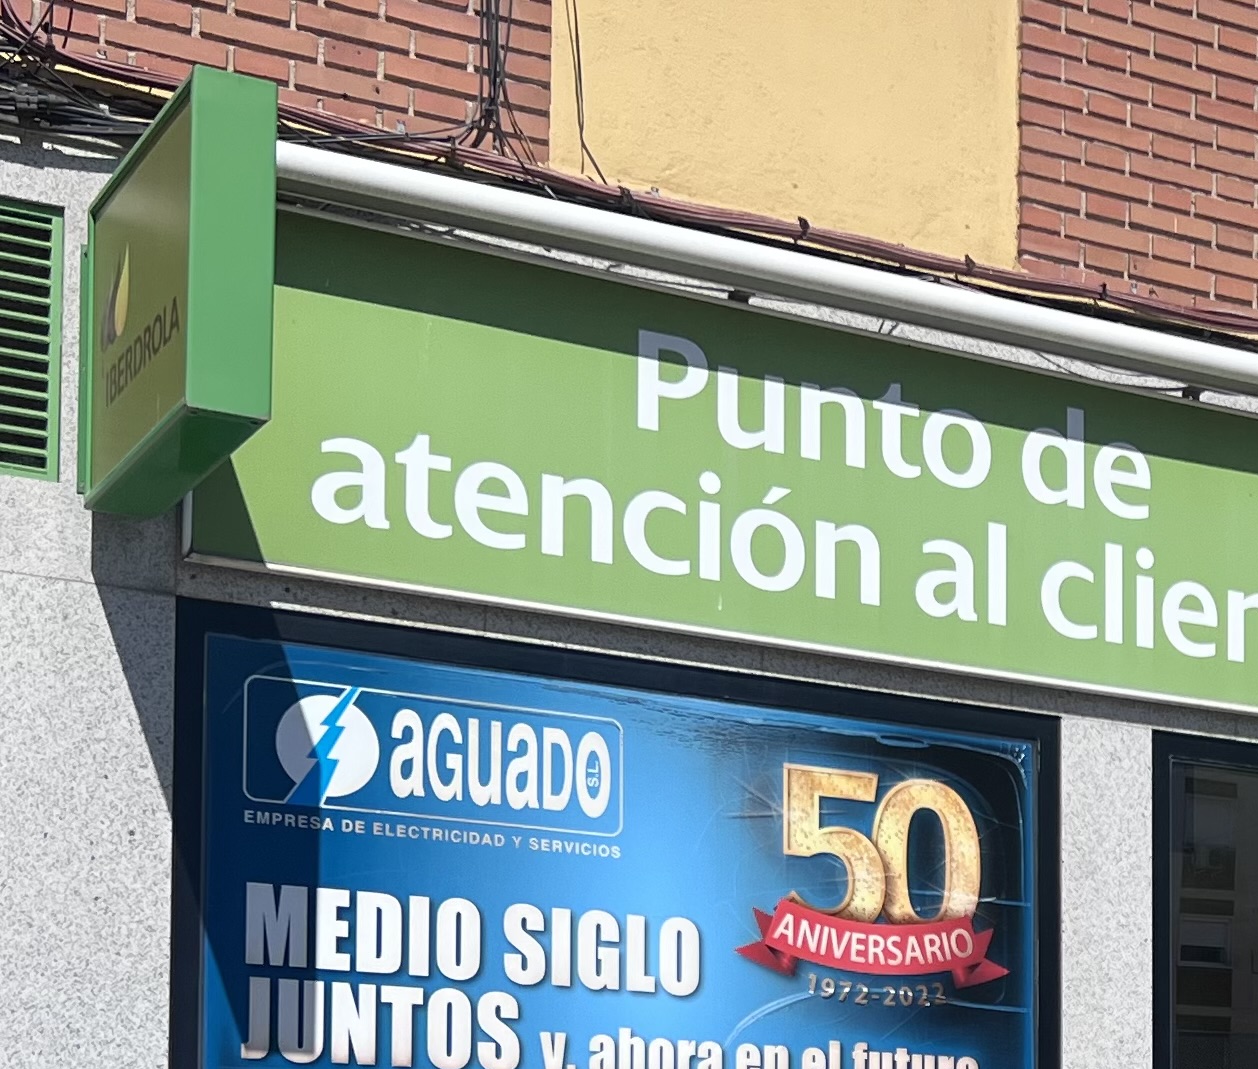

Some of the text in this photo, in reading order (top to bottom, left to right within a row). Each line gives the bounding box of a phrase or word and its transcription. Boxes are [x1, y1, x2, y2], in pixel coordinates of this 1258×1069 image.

[106, 296, 180, 408] IBERDROLA
[637, 329, 1152, 520] Punto de
[311, 434, 881, 607] atención
[915, 522, 1007, 627] al
[244, 809, 622, 859] EMPRESA DE ELECTRICIDAD Y SERVICIOS
[783, 763, 981, 925] 50
[245, 882, 702, 997] MEDIO SIGLO
[772, 913, 974, 966] ANIVERSARIO
[808, 973, 948, 1006] 1972-2022
